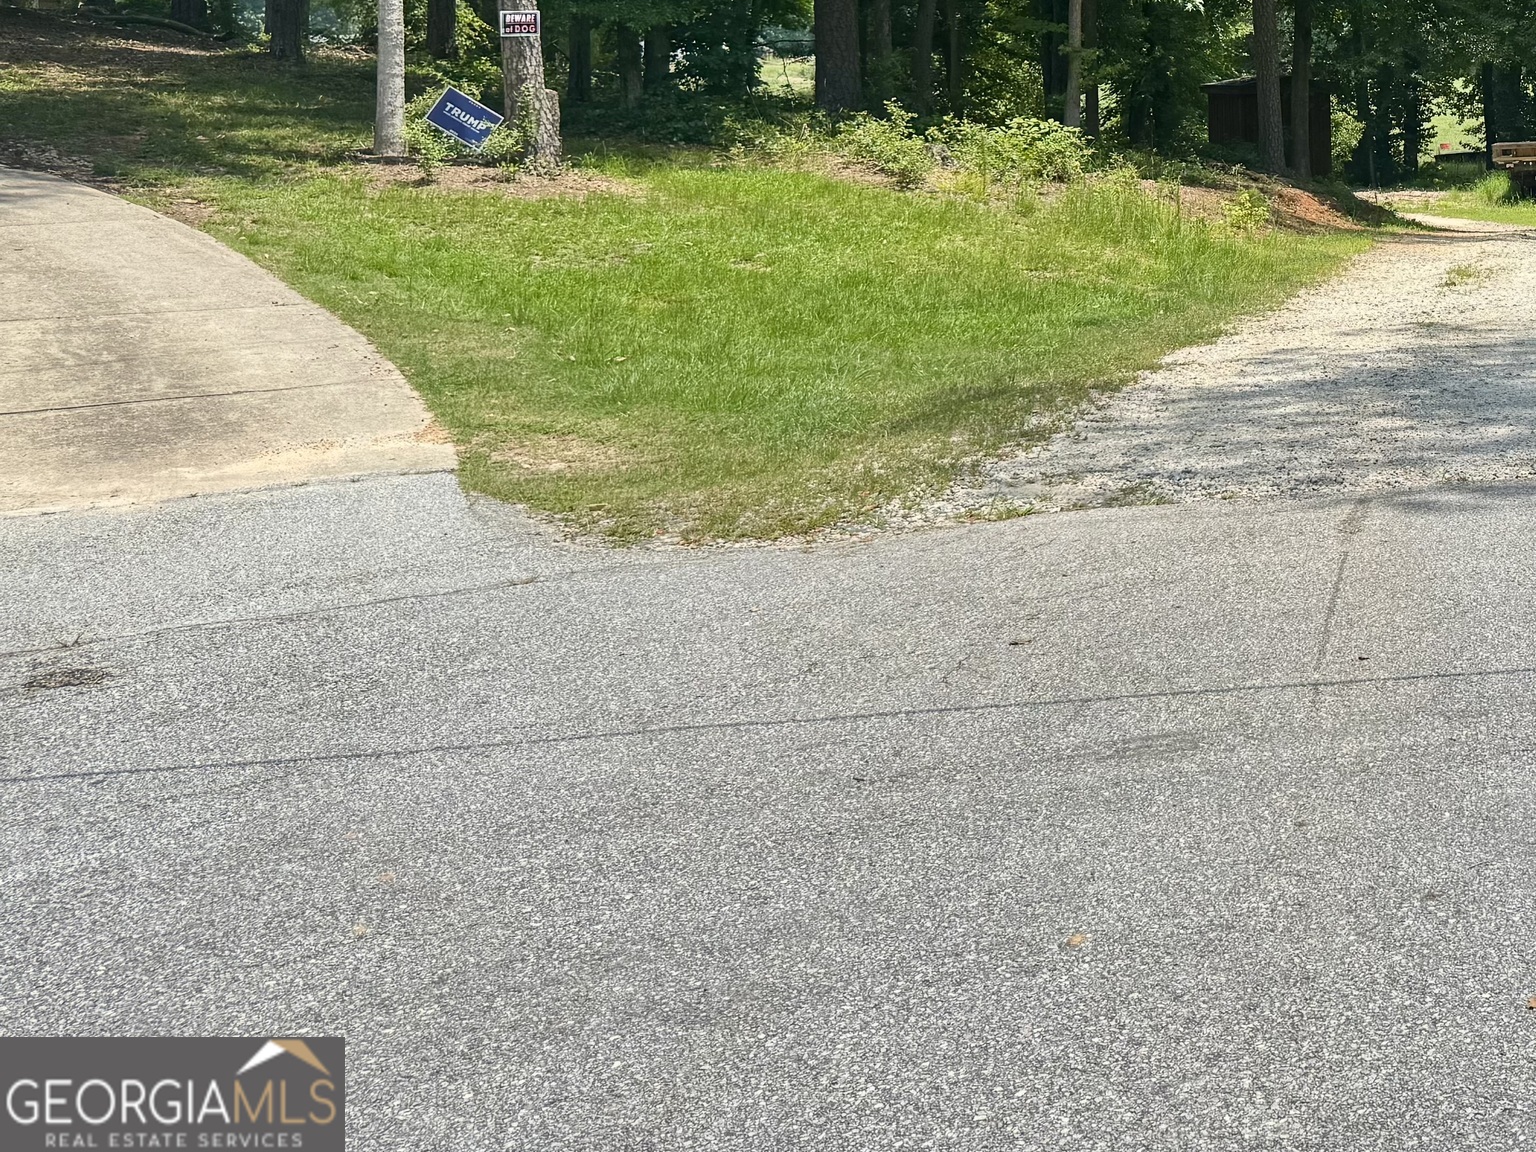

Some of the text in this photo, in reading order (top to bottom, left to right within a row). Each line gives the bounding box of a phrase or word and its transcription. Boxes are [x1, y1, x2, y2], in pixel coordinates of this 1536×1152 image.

[505, 14, 536, 23] BEWARE
[514, 24, 536, 33] DOG
[444, 101, 487, 131] TRUMP
